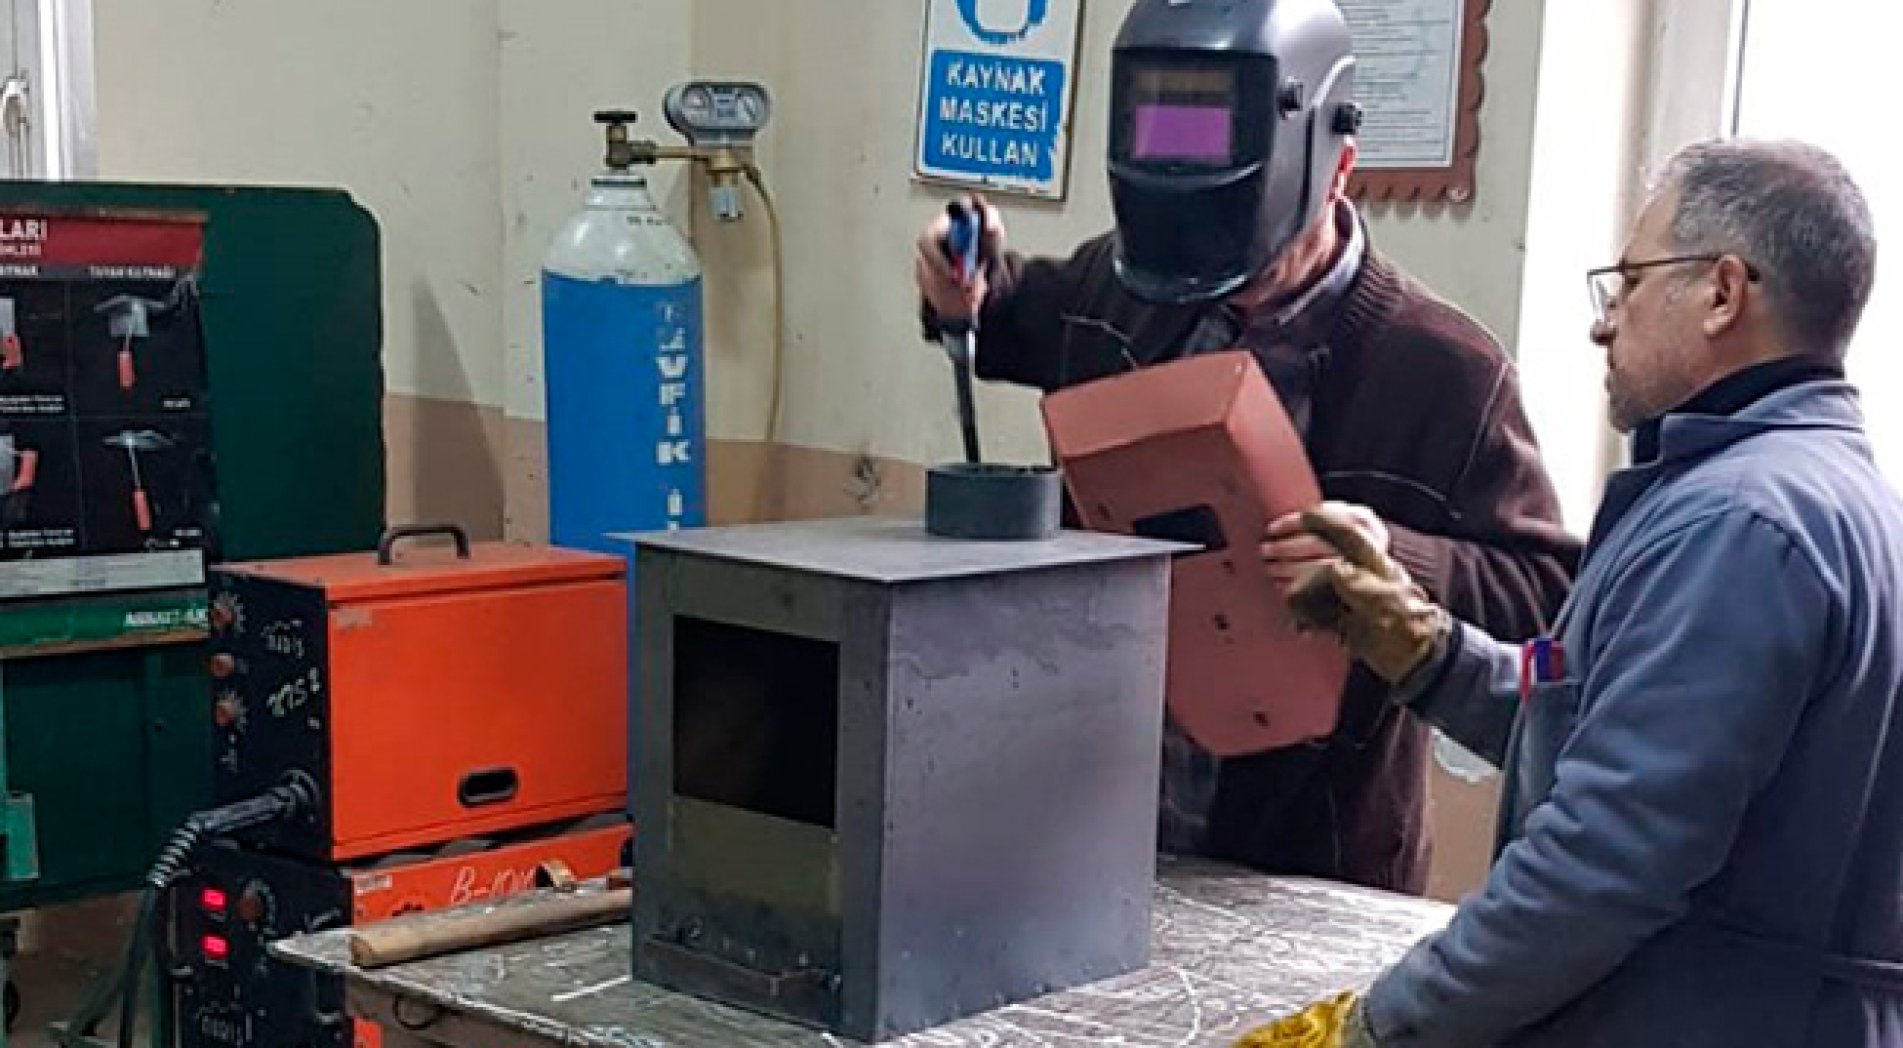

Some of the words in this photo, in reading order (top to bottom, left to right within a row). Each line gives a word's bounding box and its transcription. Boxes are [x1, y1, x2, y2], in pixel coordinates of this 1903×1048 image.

[947, 58, 1046, 96] KAYNAK
[940, 96, 1048, 132] MASKESİ
[942, 132, 1037, 167] KULLAN
